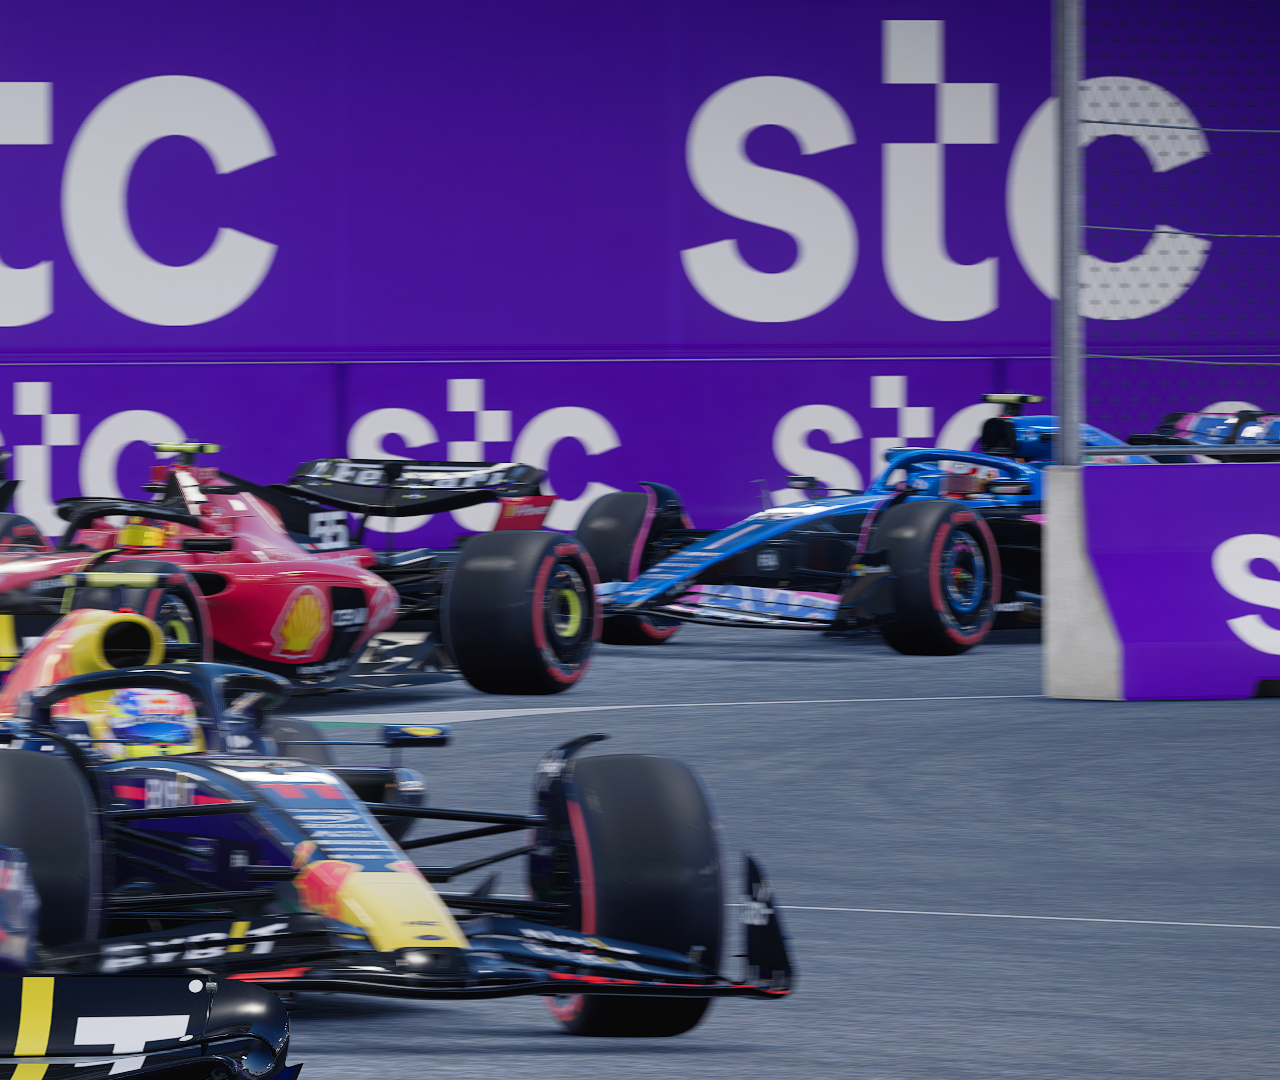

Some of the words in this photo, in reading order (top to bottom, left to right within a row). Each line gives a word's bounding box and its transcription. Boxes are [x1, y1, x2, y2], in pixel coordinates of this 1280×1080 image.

[680, 19, 1211, 322] stc
[334, 463, 507, 488] Feari
[347, 379, 621, 531] stc
[309, 511, 350, 549] 55
